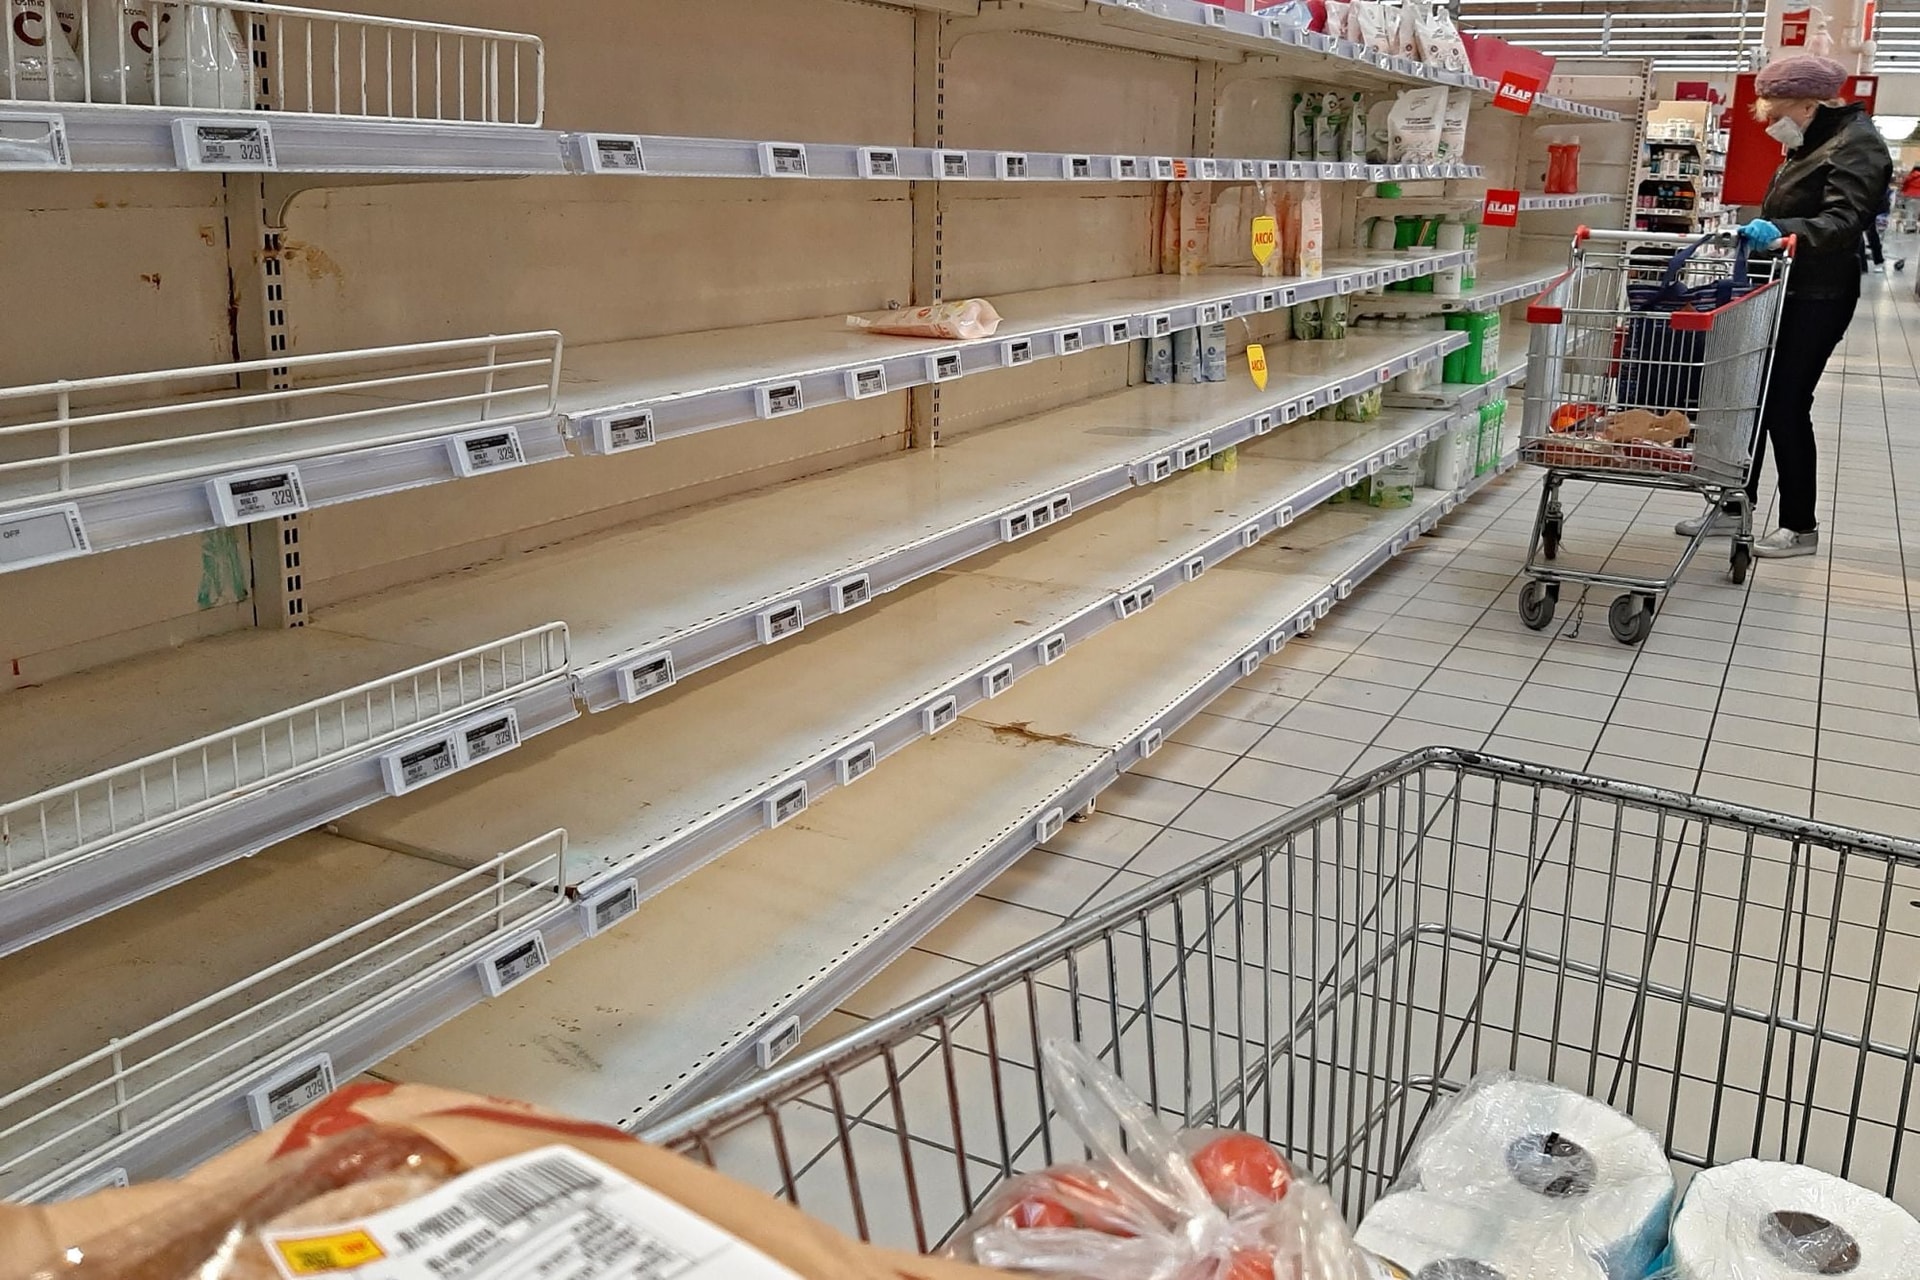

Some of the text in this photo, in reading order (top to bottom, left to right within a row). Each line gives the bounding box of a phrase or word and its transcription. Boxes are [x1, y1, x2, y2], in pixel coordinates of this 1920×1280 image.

[240, 144, 261, 160] 329
[496, 447, 514, 461] 329
[271, 488, 293, 506] 329
[3, 529, 20, 539] OFF
[494, 730, 511, 746] 329
[432, 755, 450, 771] 329
[523, 952, 539, 969] 329
[304, 1079, 325, 1099] 329
